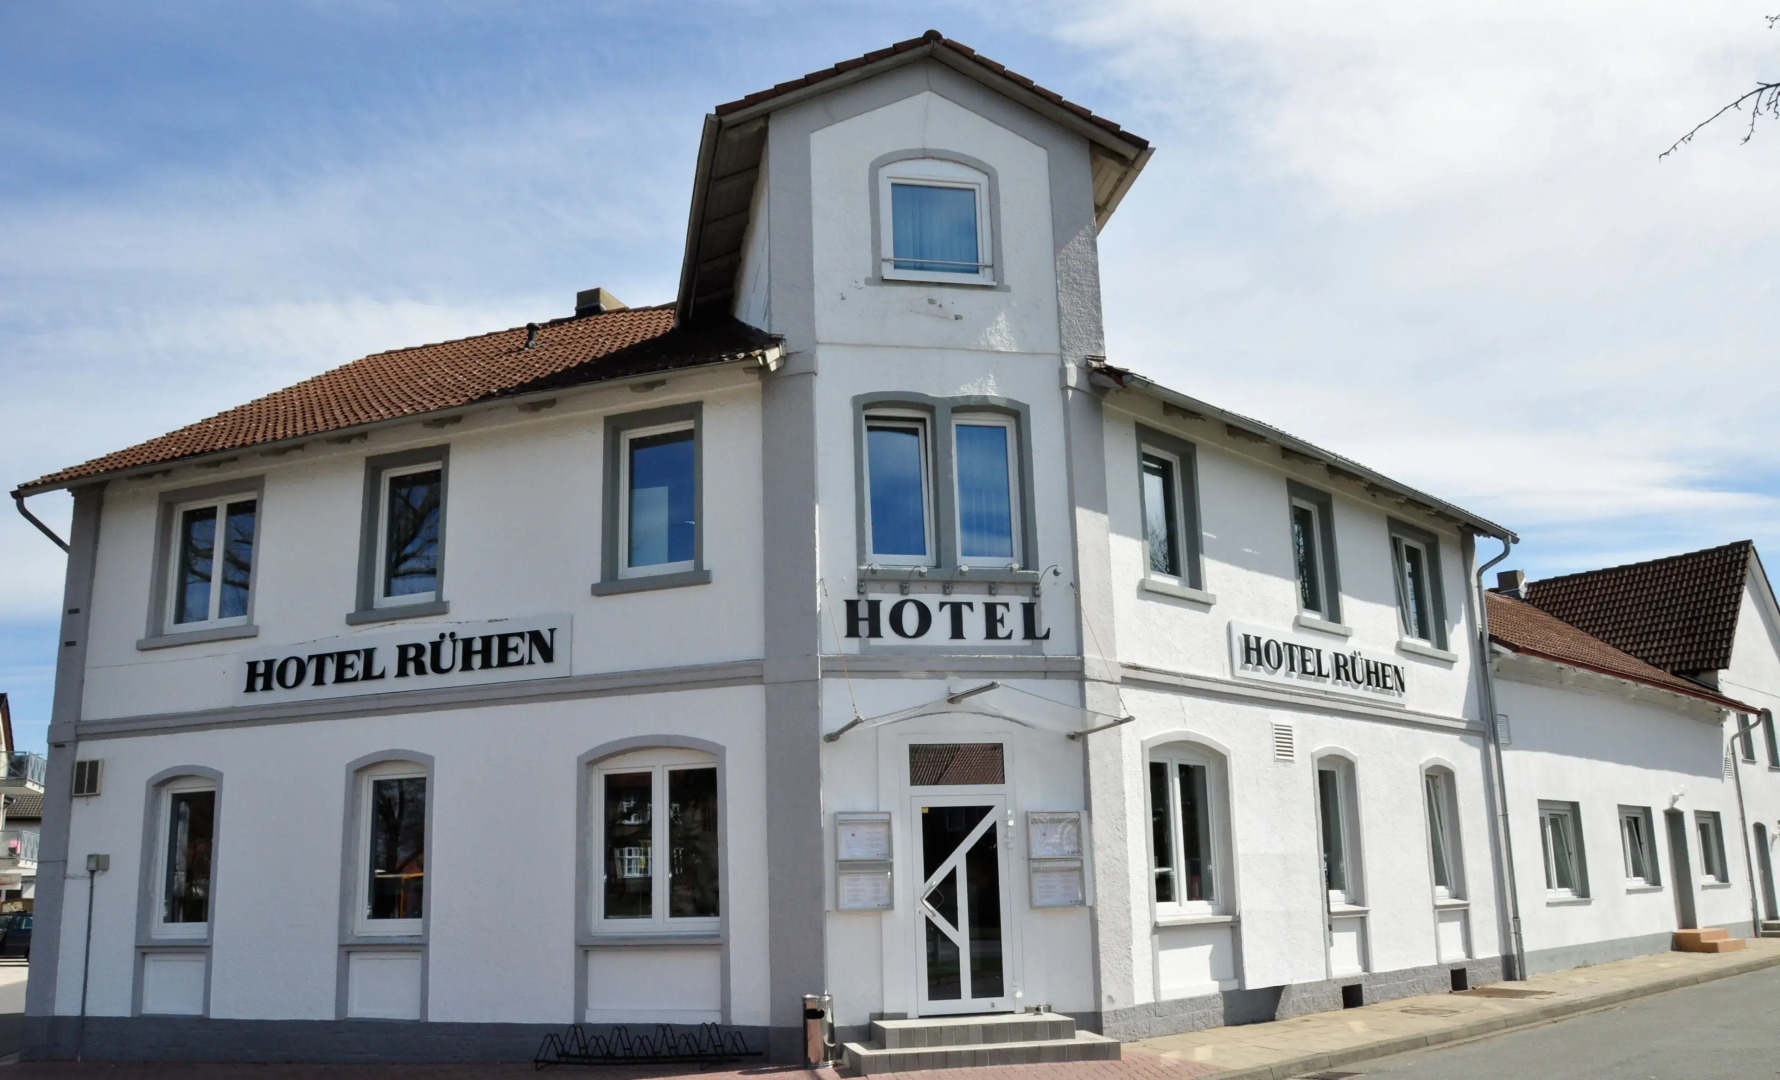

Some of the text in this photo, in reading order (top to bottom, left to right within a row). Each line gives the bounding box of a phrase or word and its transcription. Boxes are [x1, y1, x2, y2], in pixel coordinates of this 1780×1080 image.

[844, 599, 1050, 640] HOTEL
[243, 628, 557, 693] HOTEL RÜHEN
[1242, 633, 1406, 693] HOTEL RÜHEN
